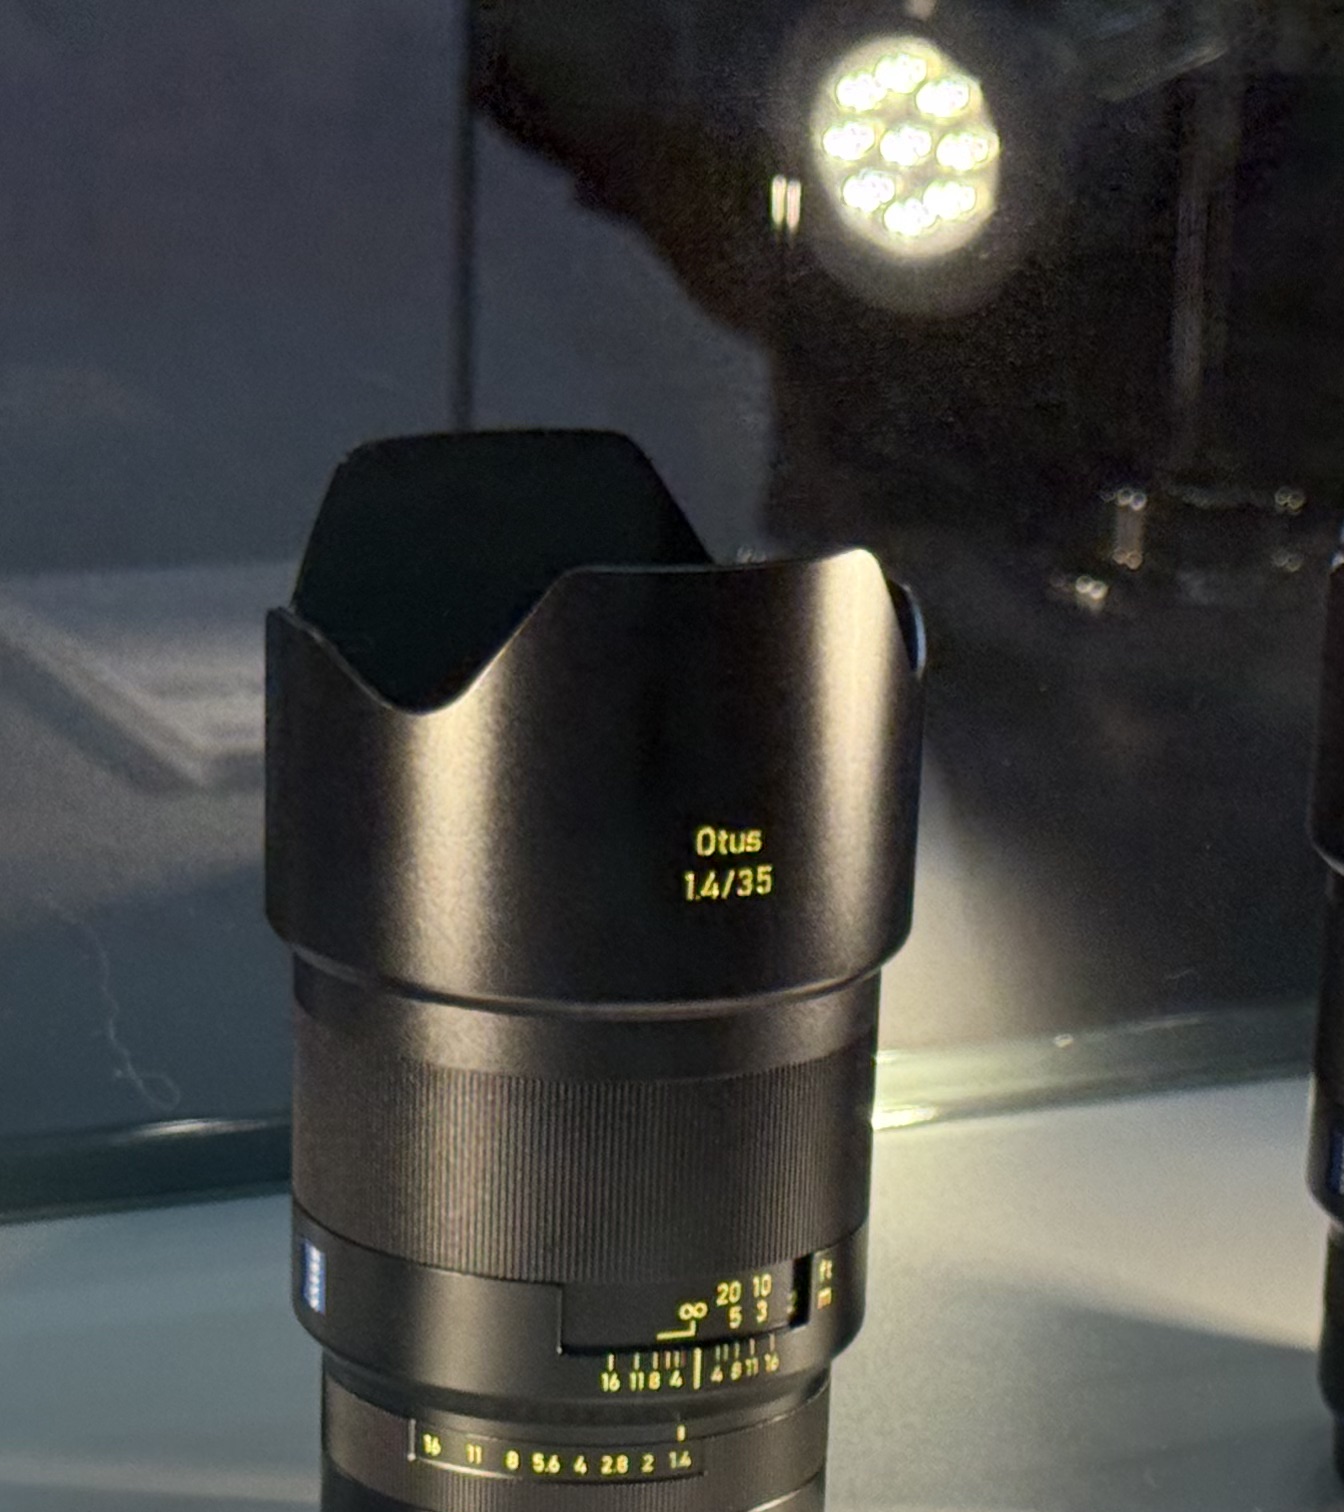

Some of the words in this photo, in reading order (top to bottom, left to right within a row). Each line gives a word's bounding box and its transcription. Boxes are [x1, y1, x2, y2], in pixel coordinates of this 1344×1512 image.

[696, 826, 763, 857] Otus
[684, 865, 774, 900] 1.4/35
[716, 1280, 742, 1306] 20
[752, 1273, 772, 1298] 10
[729, 1305, 743, 1329] 5
[756, 1299, 768, 1323] 3
[601, 1371, 621, 1392] 16
[629, 1371, 645, 1391] 11
[669, 1369, 684, 1388] 4
[423, 1433, 441, 1456] 16
[466, 1443, 482, 1464] 11
[532, 1452, 560, 1473] 5.6
[573, 1455, 588, 1475] 4
[641, 1453, 655, 1473] 2
